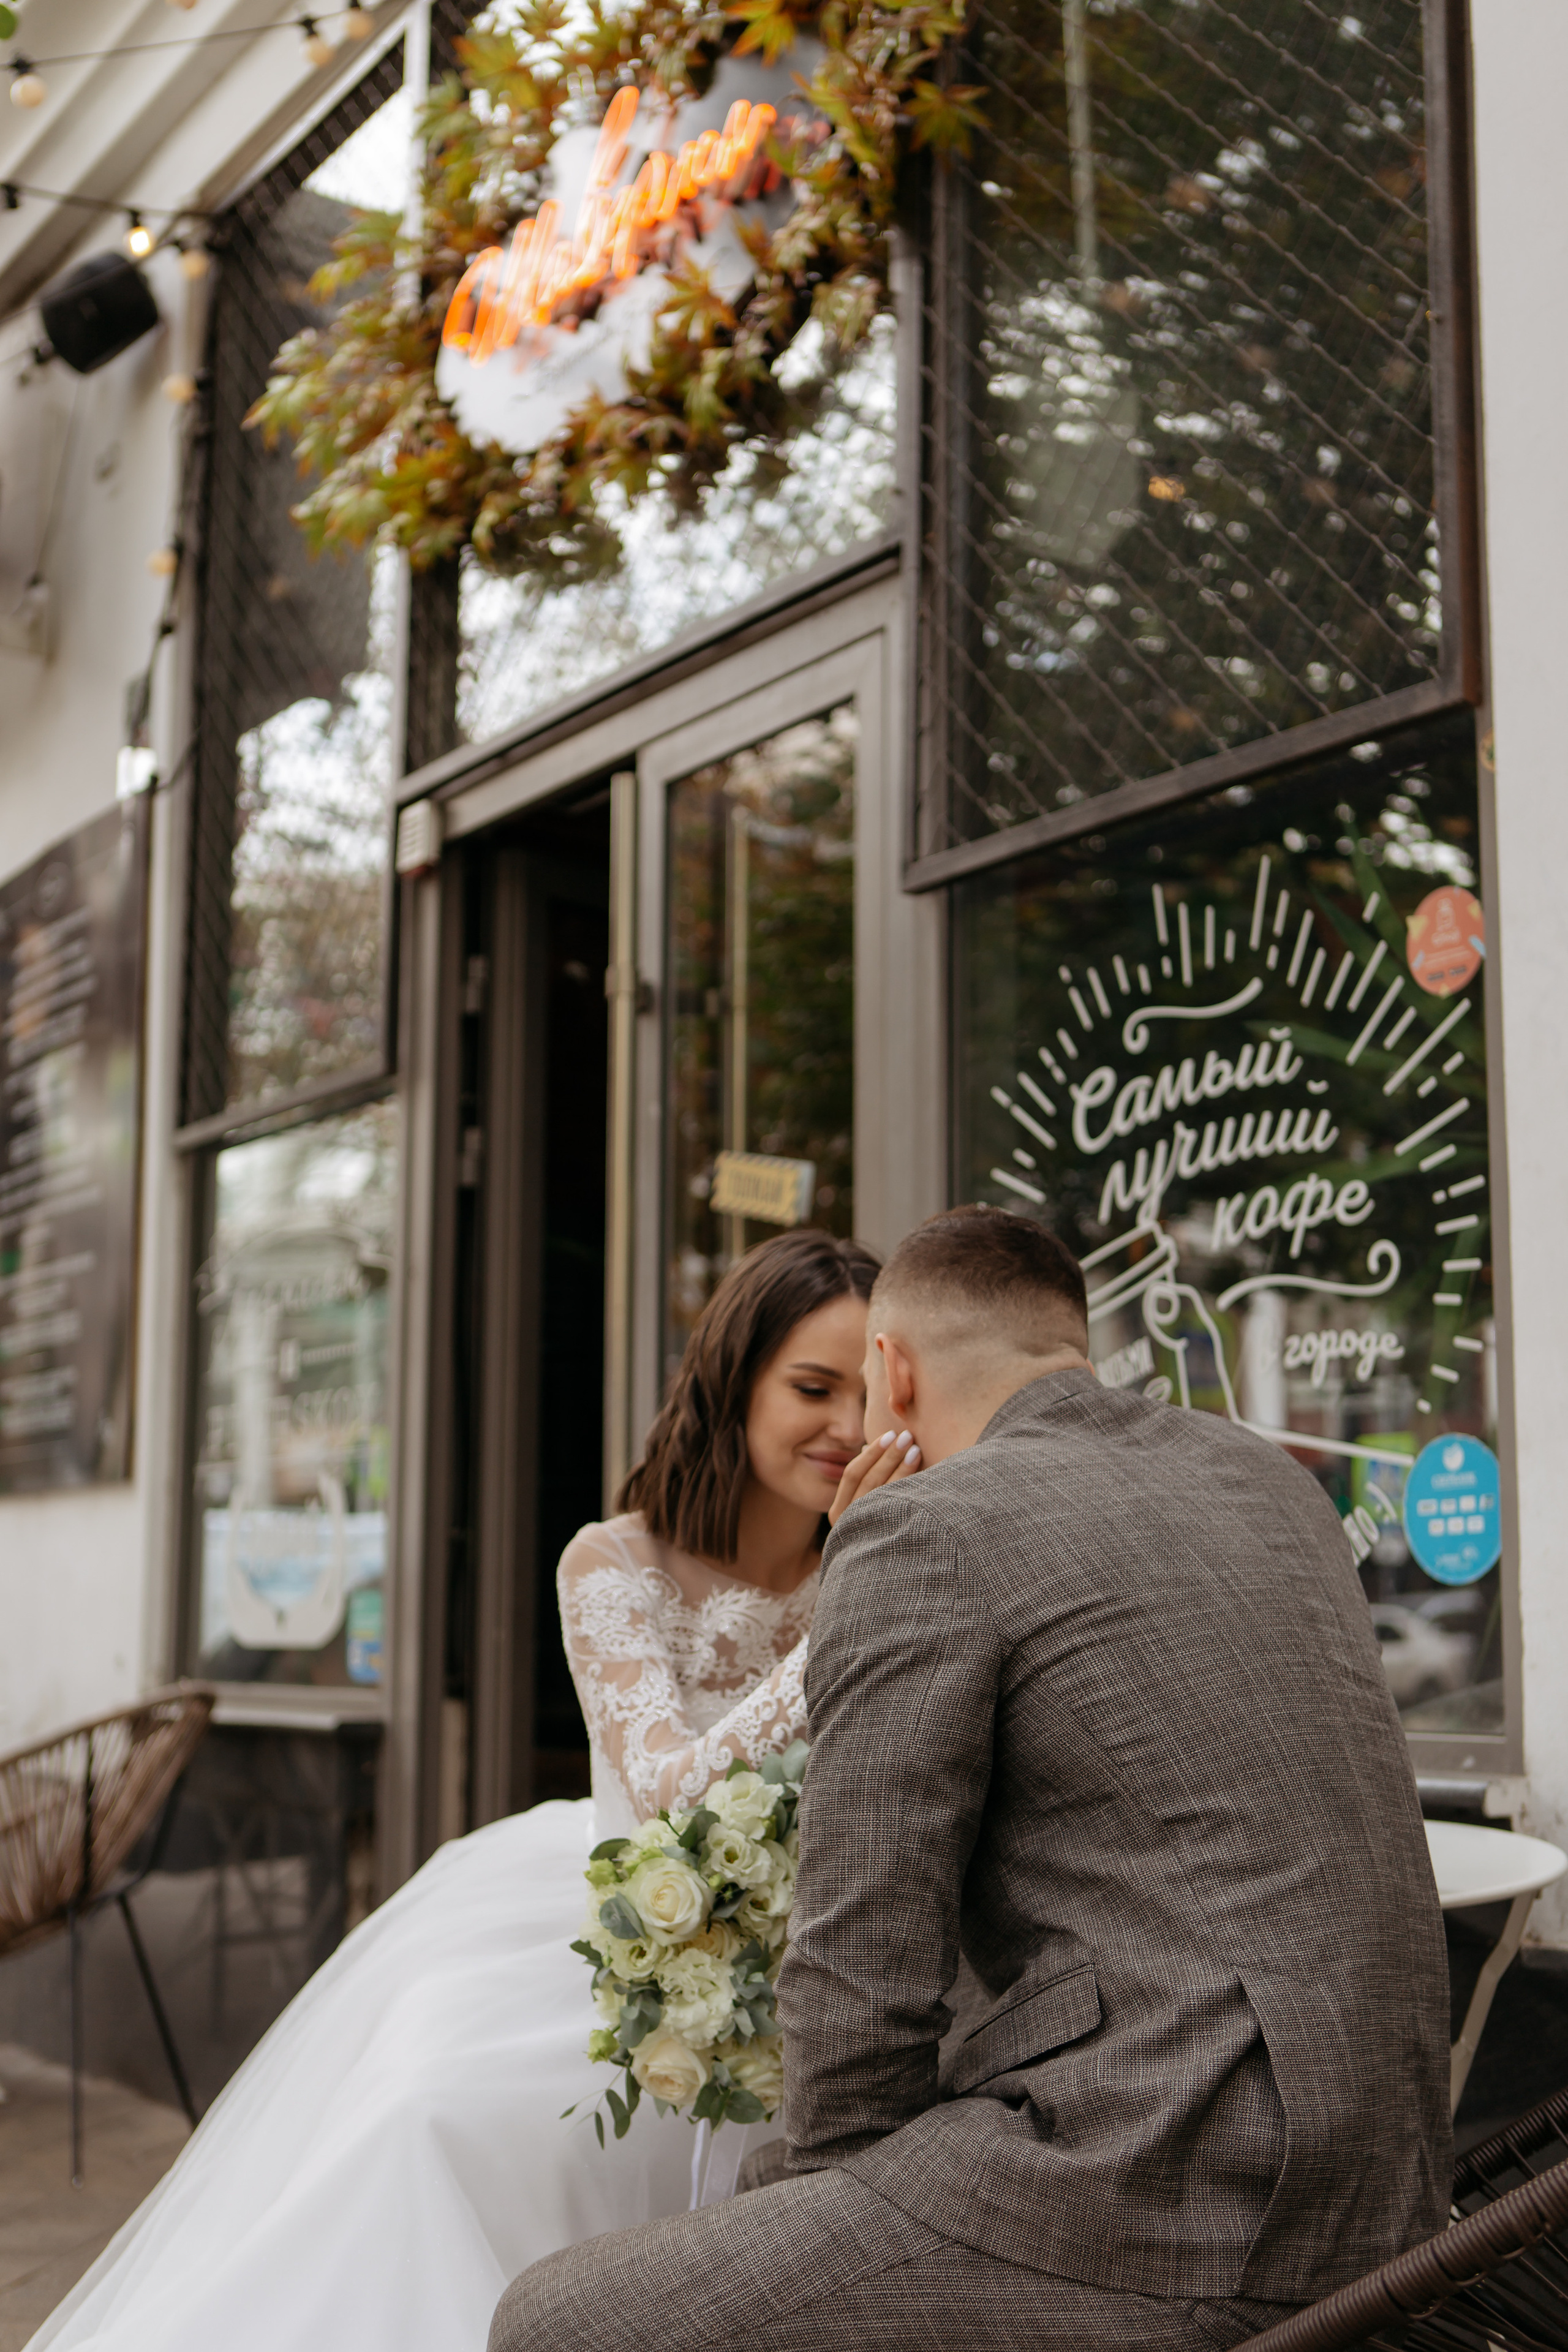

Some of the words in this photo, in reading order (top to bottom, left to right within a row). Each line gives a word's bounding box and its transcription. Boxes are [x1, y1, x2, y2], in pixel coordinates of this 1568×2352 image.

[1070, 1027, 1303, 1153] Самый
[1098, 1080, 1339, 1226] лучший
[1212, 1174, 1374, 1258] кофе
[1284, 1329, 1404, 1388] городе
